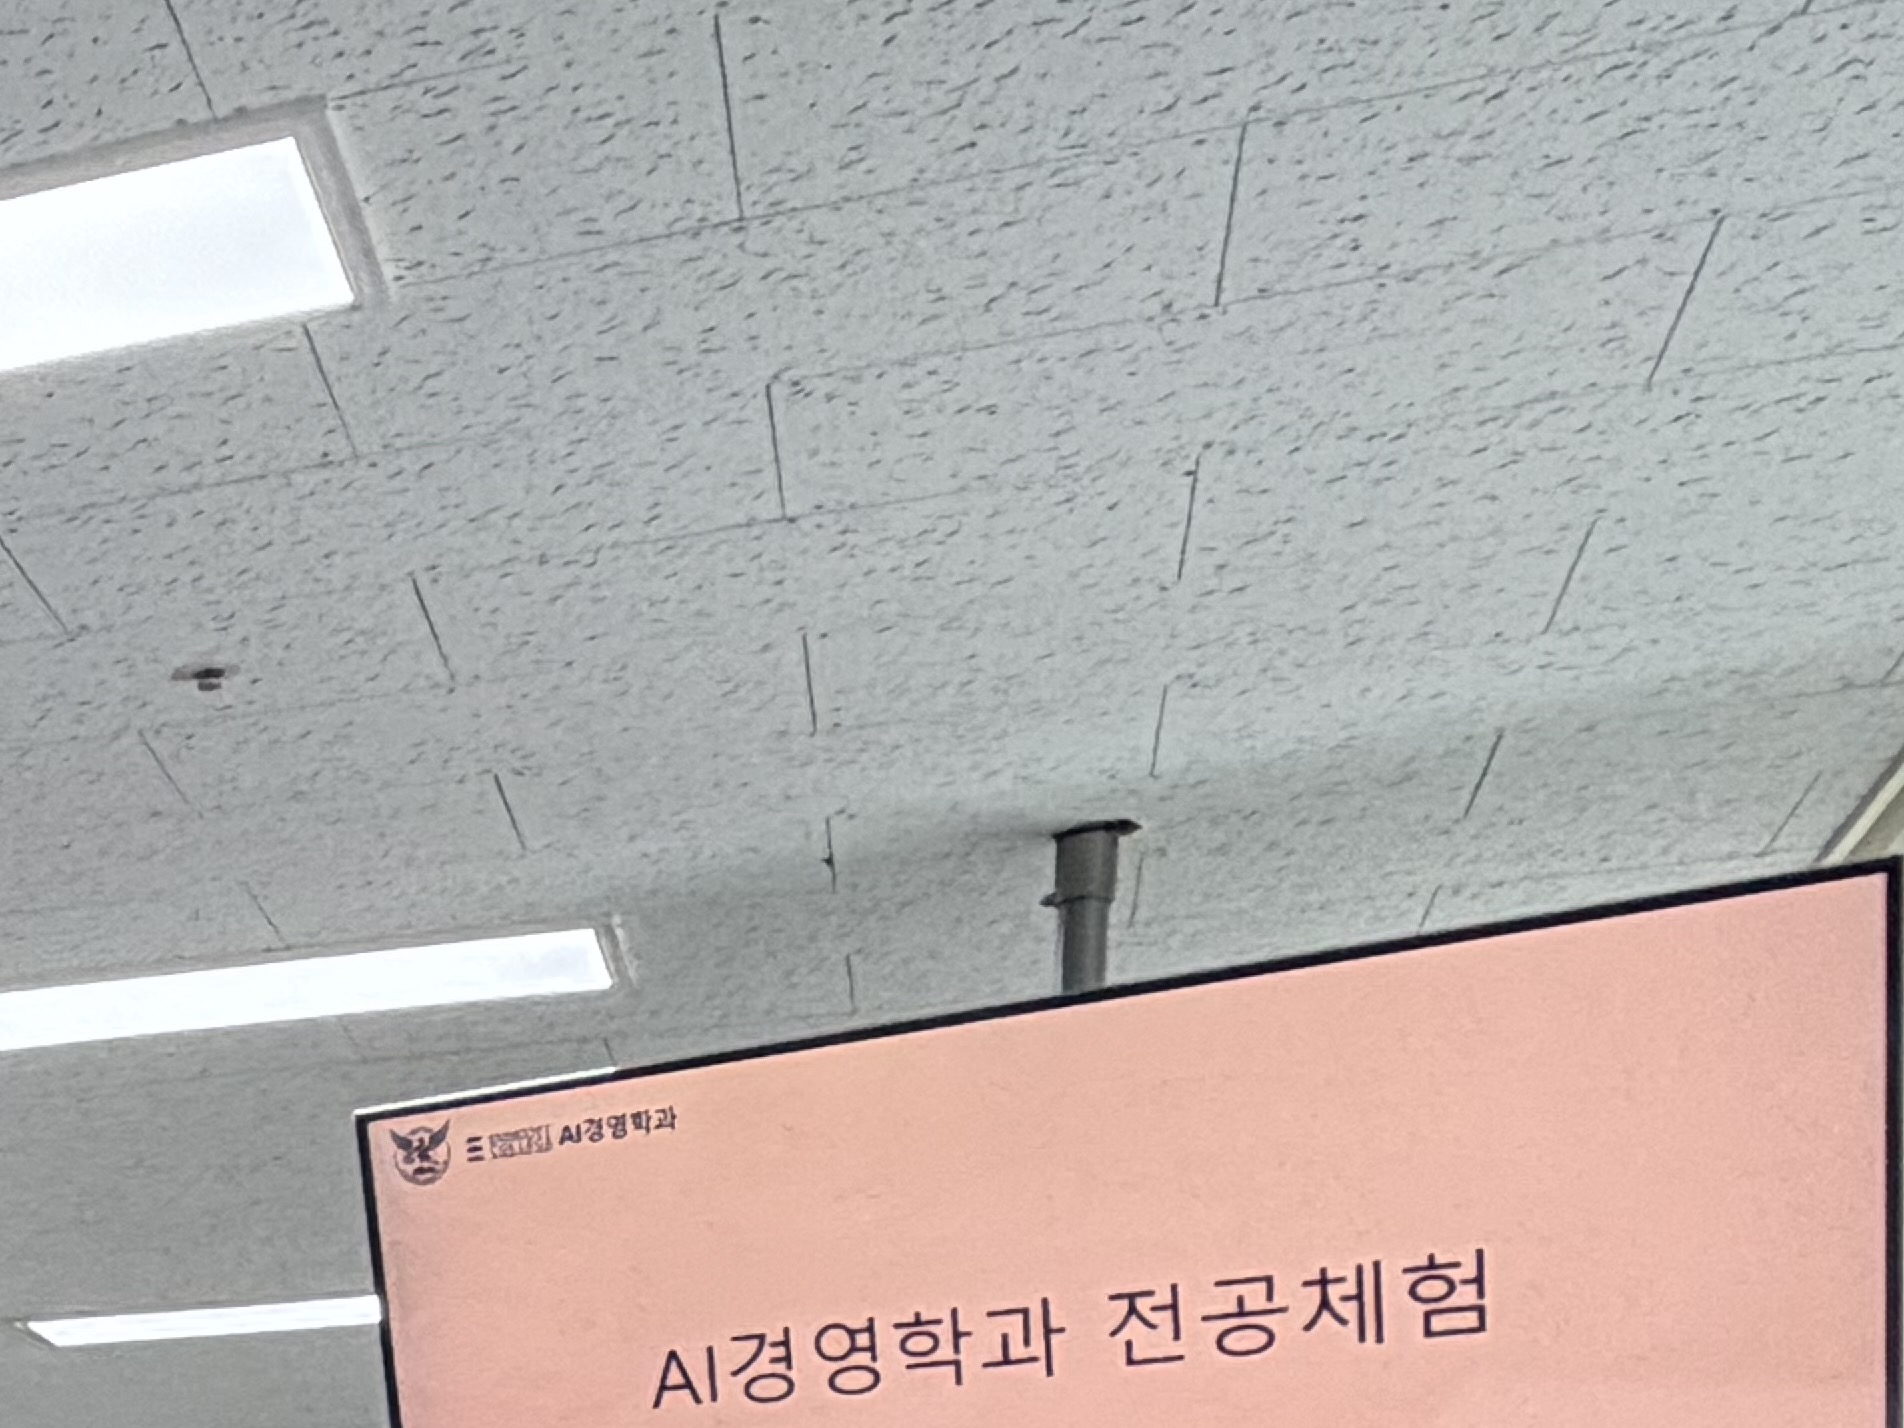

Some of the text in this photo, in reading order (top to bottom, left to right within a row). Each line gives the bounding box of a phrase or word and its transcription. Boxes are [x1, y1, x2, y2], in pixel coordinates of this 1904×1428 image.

[559, 1105, 677, 1145] AI경영학과
[652, 1246, 1490, 1410] AI경영학과 전공체험
